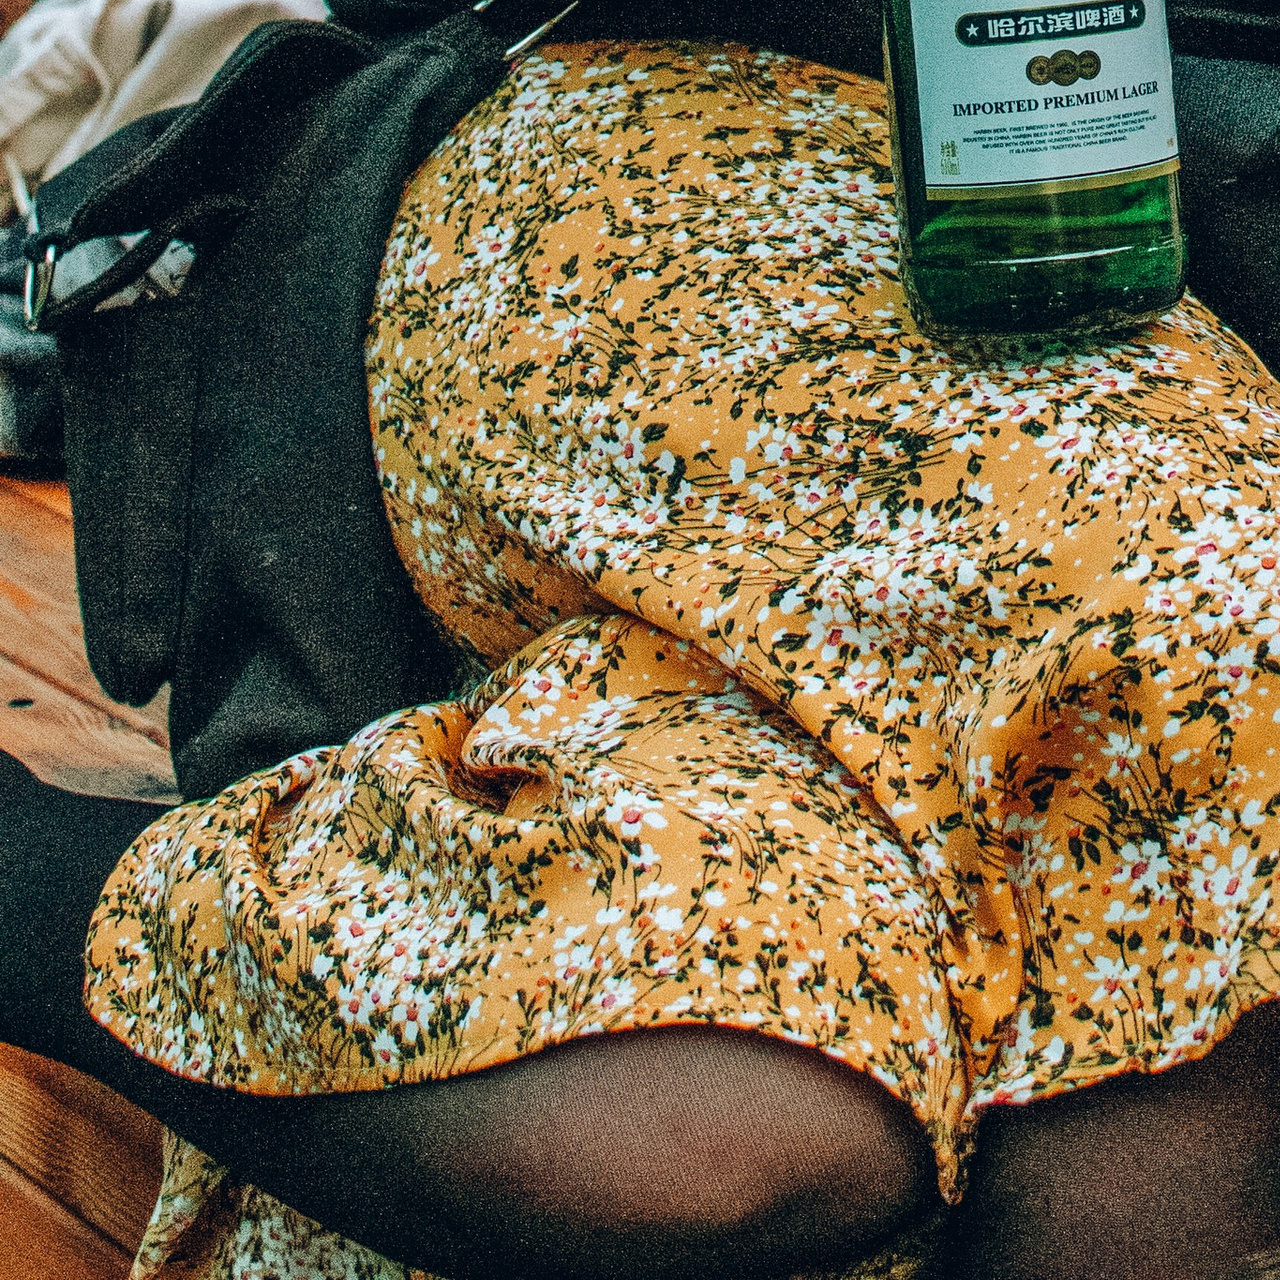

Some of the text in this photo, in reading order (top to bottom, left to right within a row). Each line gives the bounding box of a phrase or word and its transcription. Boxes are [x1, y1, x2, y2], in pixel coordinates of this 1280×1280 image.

[987, 4, 1126, 39] 哈尔滨啤酒
[952, 80, 1160, 117] IMPORTED PREMIUM LAGER
